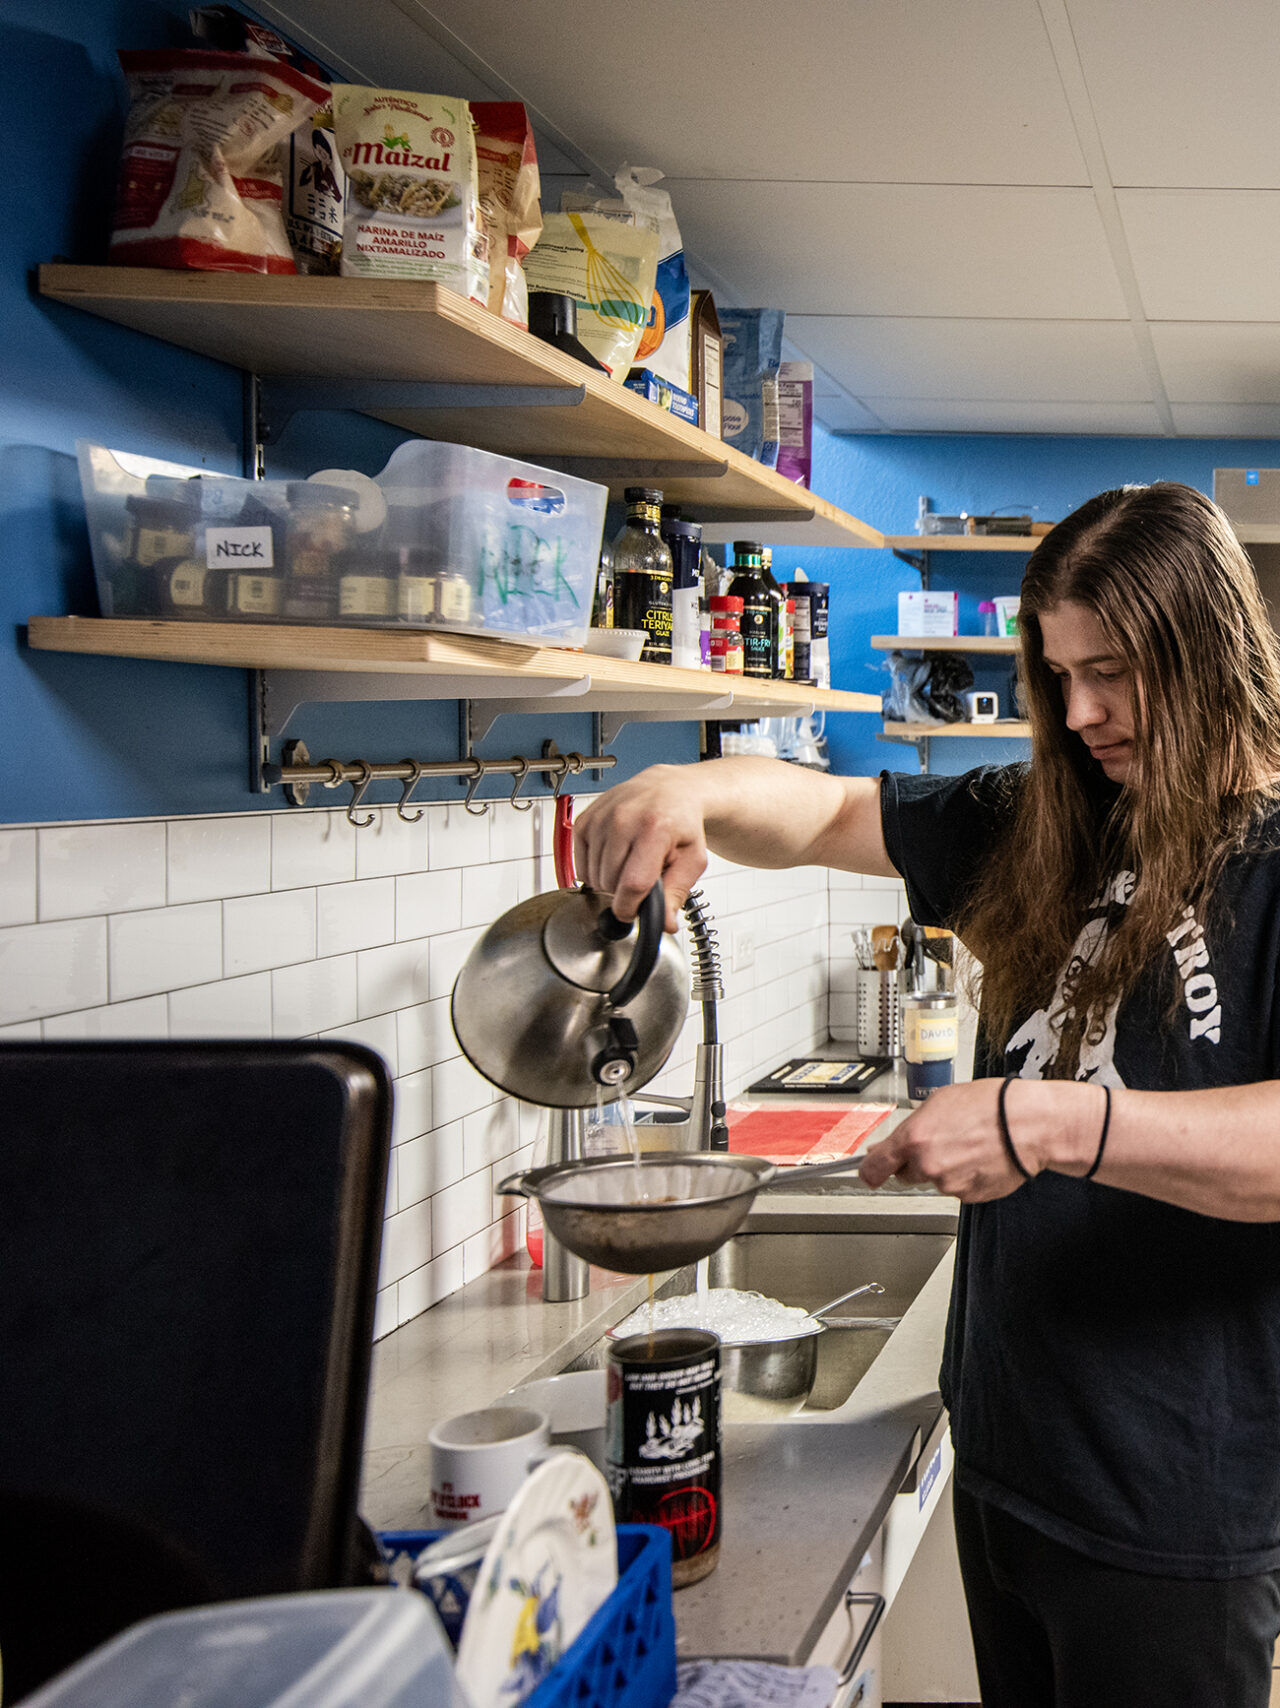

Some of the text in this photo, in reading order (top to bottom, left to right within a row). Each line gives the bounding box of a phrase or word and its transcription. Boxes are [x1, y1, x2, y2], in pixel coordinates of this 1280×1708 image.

[352, 142, 451, 172] Maizal
[357, 224, 445, 242] HARINA DE MAÍZ
[372, 236, 427, 249] AMARILLO
[356, 243, 446, 259] NIXTAMALIZADO
[215, 540, 265, 559] NICK
[641, 619, 673, 630] TERIYA
[744, 637, 771, 648] TIR-FRY
[920, 1028, 954, 1041] DAVID
